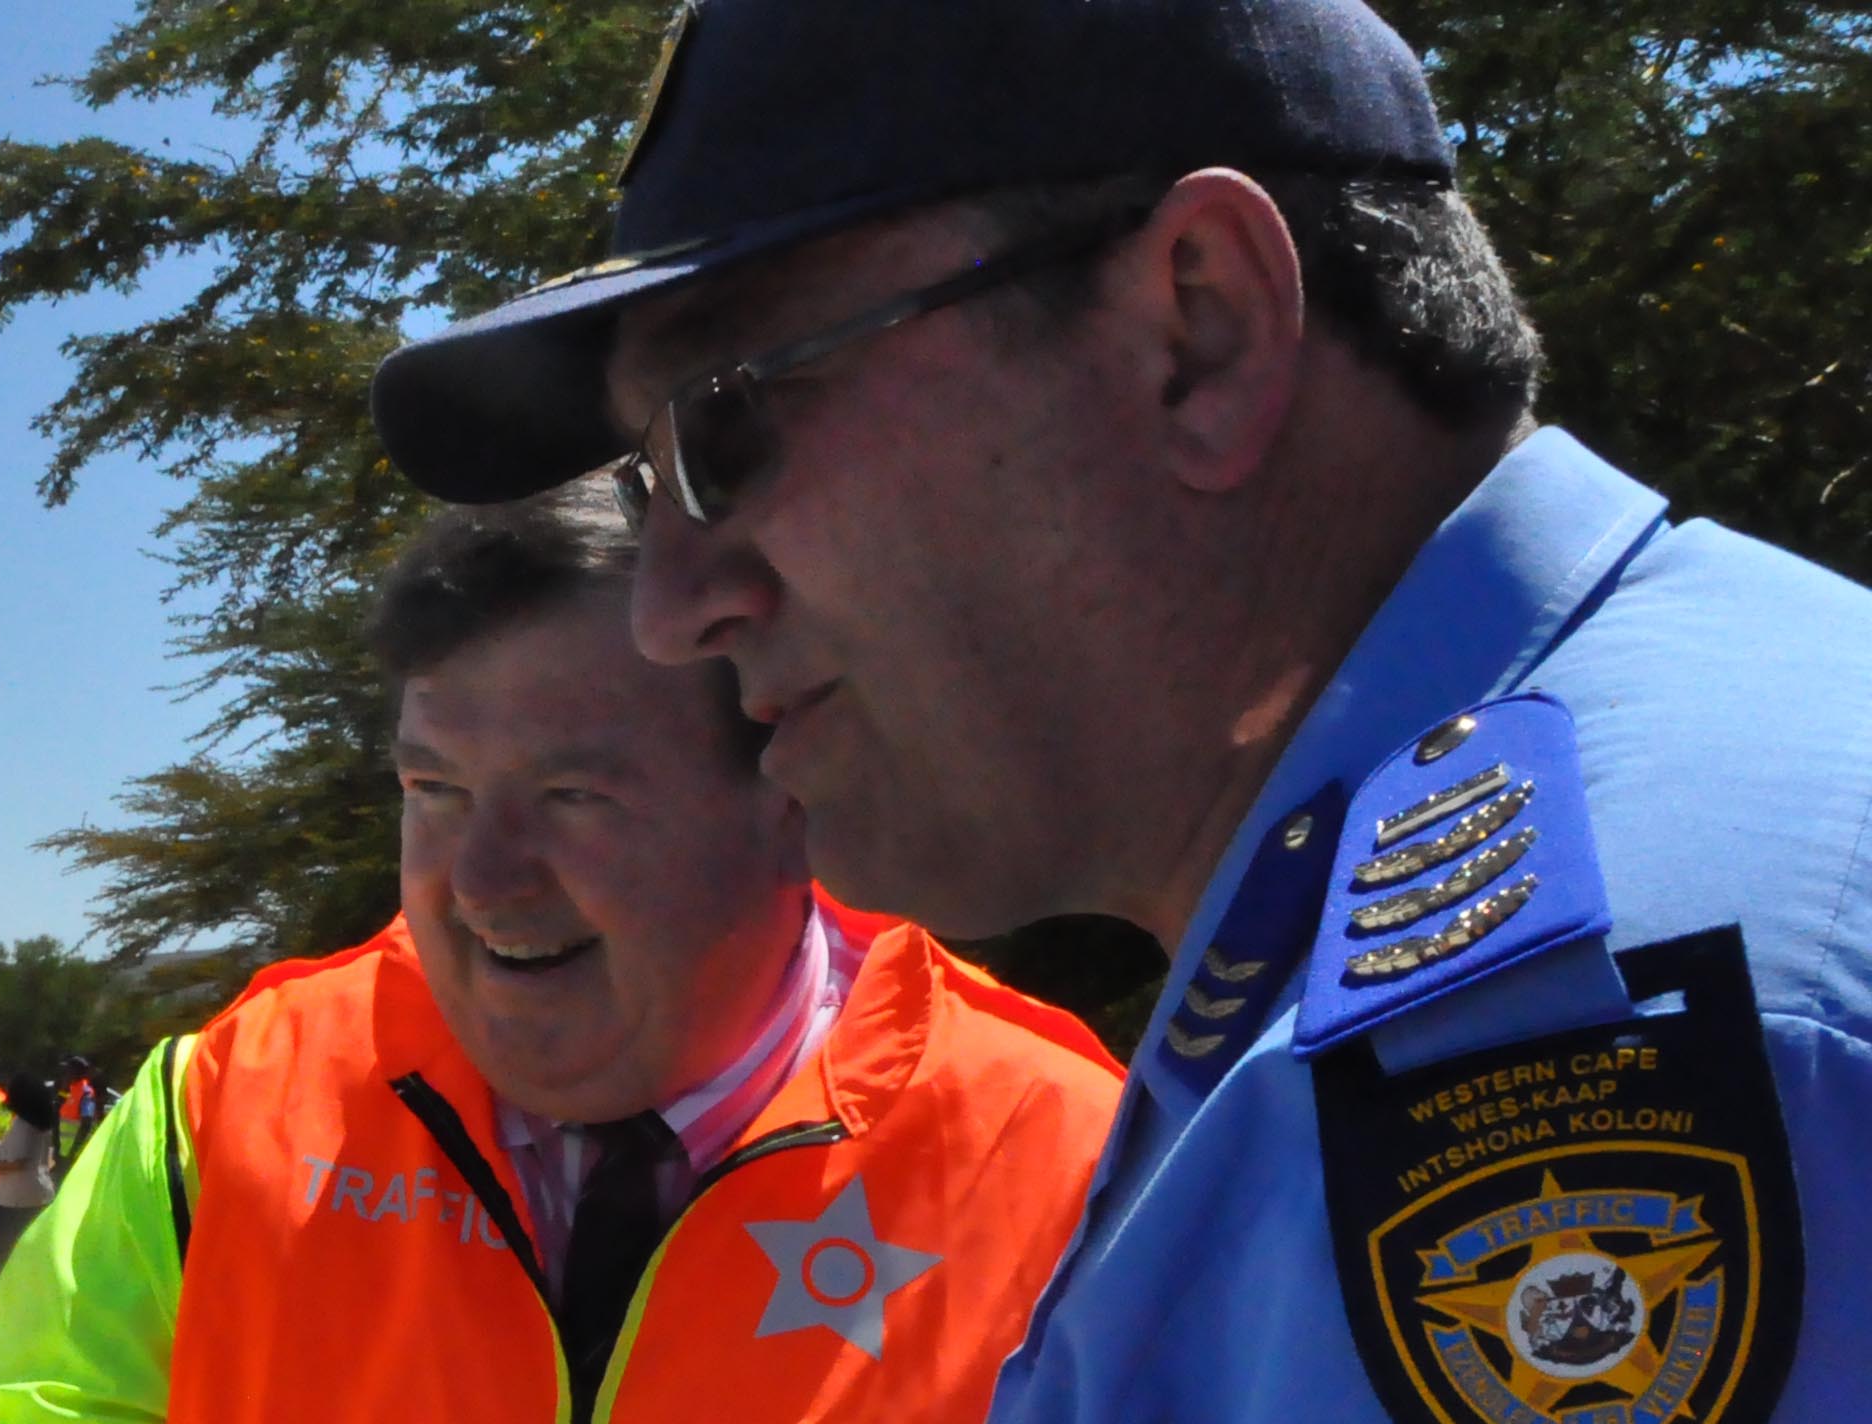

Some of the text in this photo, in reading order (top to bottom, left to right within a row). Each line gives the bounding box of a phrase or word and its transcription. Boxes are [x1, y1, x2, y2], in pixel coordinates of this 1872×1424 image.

[1408, 1048, 1659, 1123] WESTERN CAPE
[1450, 1080, 1617, 1133] WES-KAAP
[1397, 1108, 1694, 1193] INTSHONA KOLONI
[1479, 1199, 1635, 1247] TRAFFIC
